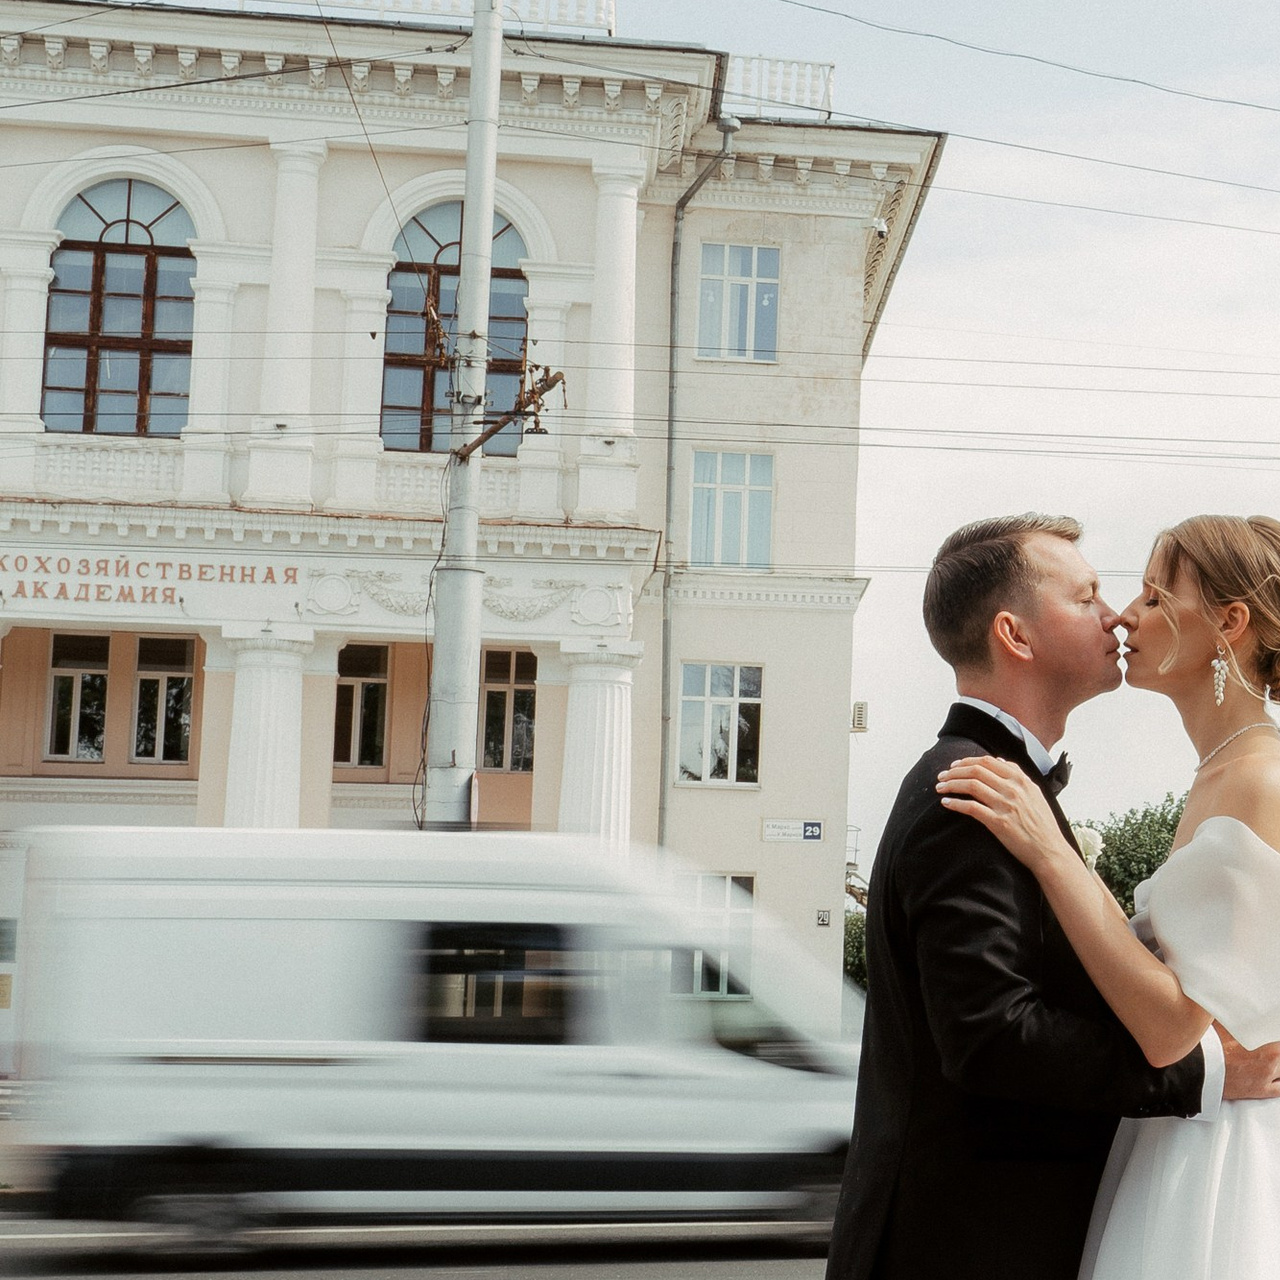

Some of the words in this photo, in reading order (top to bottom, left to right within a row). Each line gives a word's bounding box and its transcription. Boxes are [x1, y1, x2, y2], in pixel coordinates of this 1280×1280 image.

[11, 580, 176, 604] АКАДЕМИЯ
[805, 826, 820, 836] 29
[818, 911, 829, 924] 29
